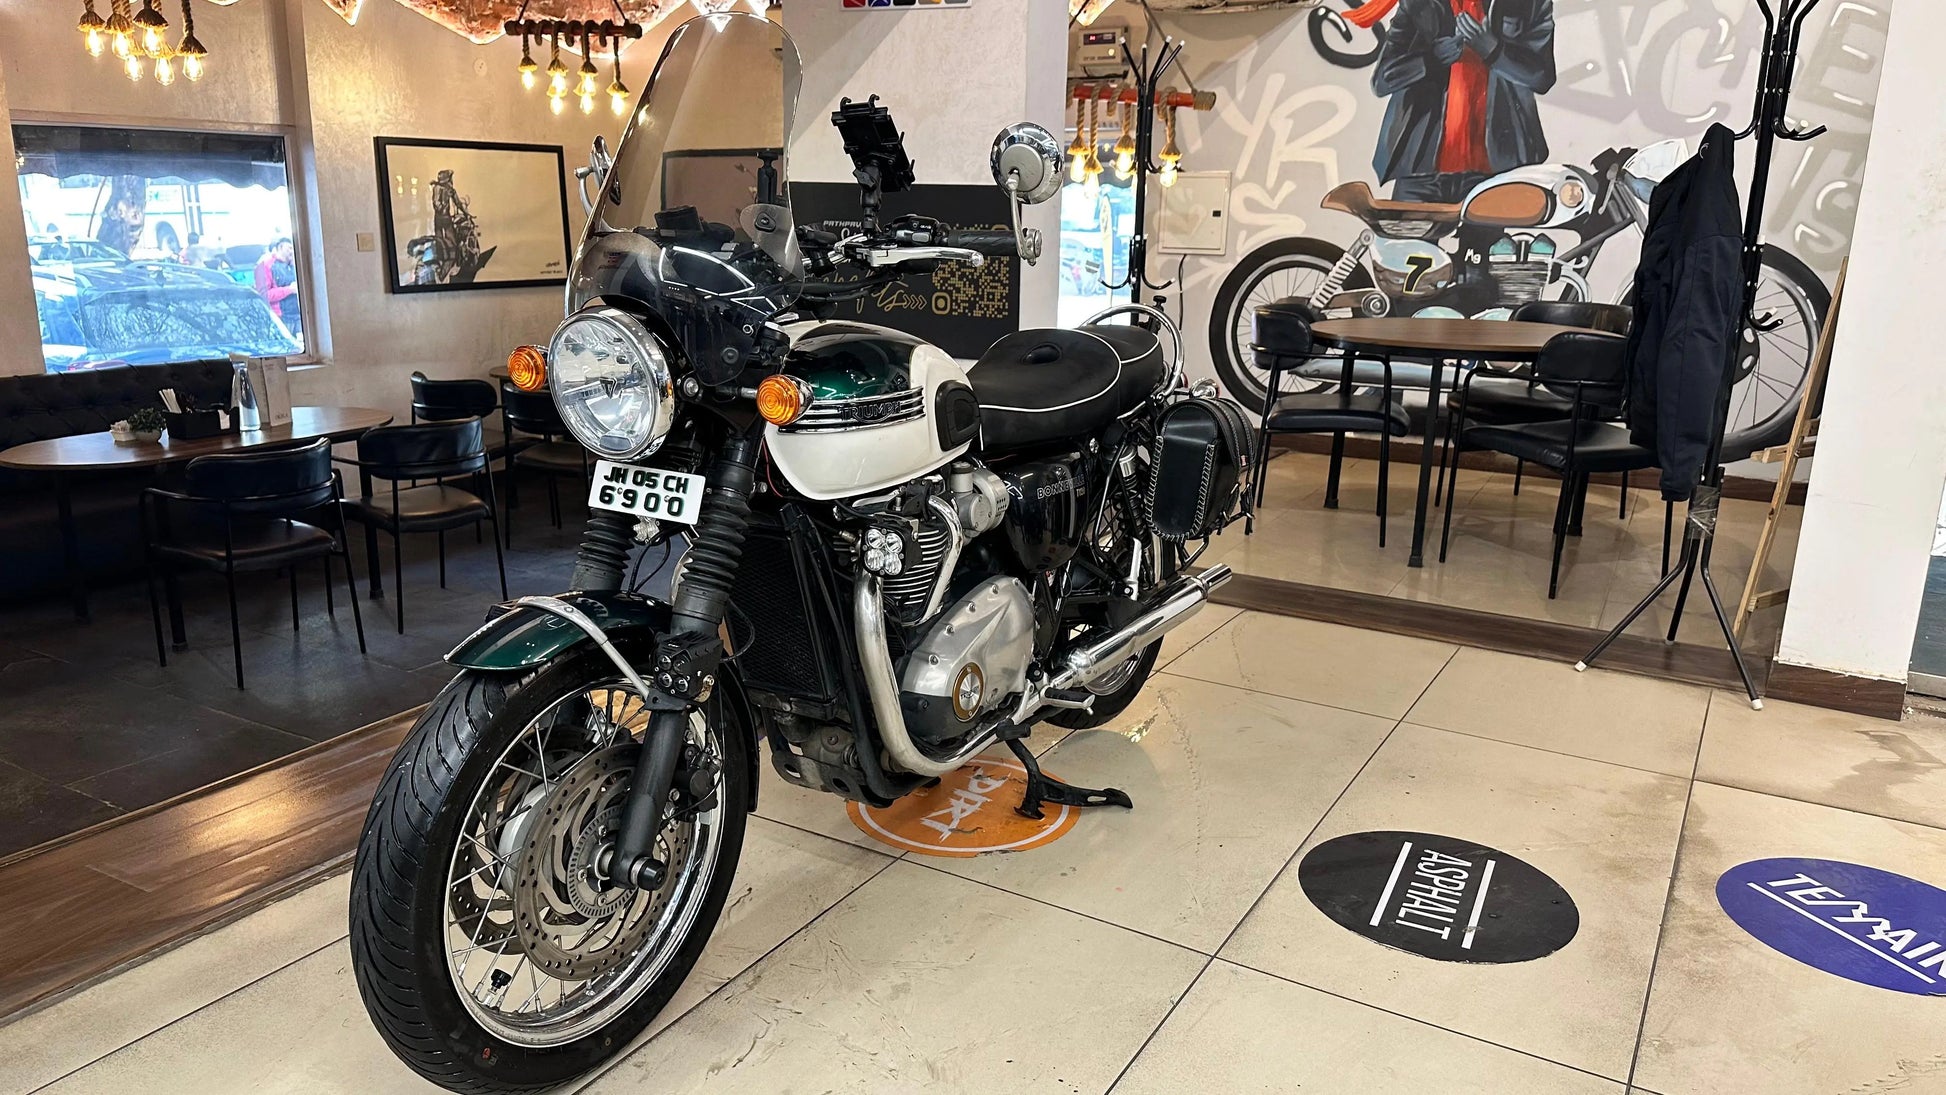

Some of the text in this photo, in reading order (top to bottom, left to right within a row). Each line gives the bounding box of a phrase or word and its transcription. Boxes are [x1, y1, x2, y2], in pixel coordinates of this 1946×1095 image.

[1464, 248, 1482, 264] Mg
[1402, 253, 1434, 295] 7
[837, 400, 901, 421] TRIUMPH
[604, 466, 690, 494] JH 05 CH
[919, 766, 1011, 842] DIRT
[1395, 849, 1473, 940] ASPHALT
